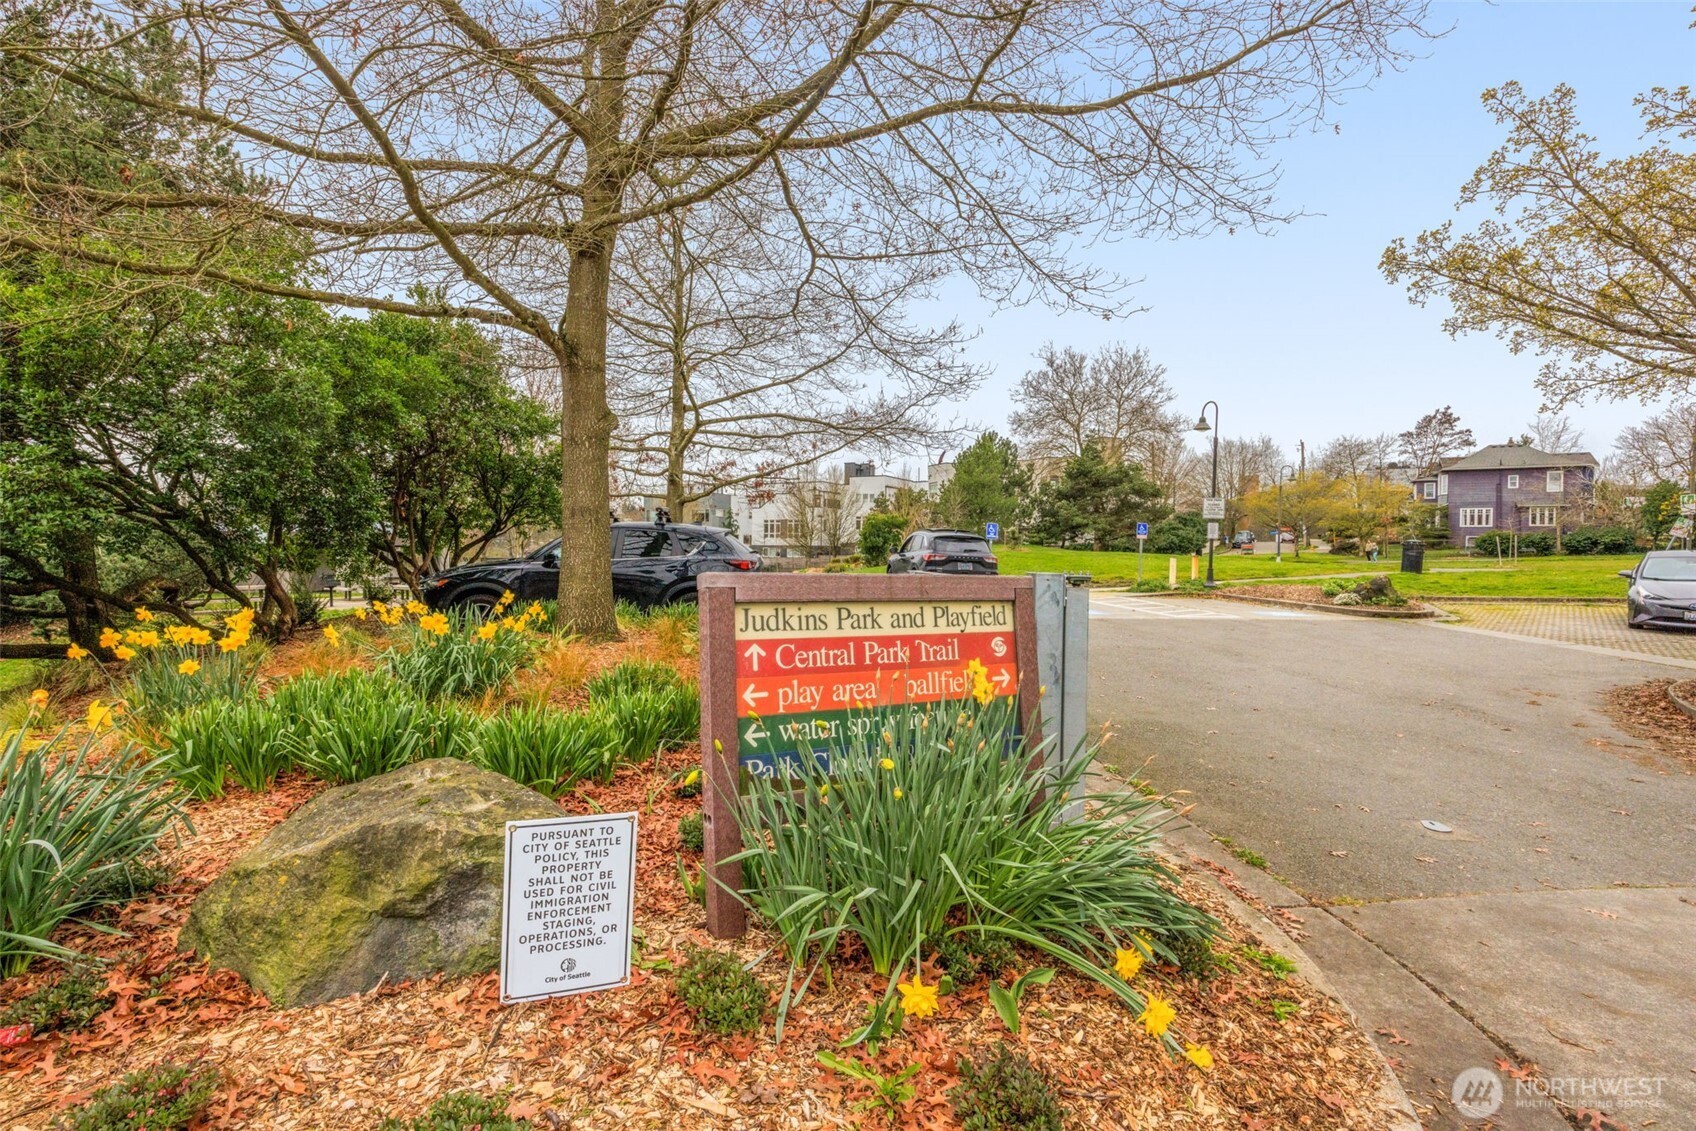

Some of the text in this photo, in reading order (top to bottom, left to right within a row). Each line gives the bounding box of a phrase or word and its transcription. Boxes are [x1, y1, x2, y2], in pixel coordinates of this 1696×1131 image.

[740, 604, 1007, 633] Judkins Park and Playfield
[775, 638, 960, 669] Central Park Trail
[904, 669, 977, 697] ballfiel
[778, 680, 878, 713] play area
[847, 713, 901, 742] spry
[531, 826, 614, 842] PURSUANT TO
[522, 836, 621, 854] CITY OF SEATTLE
[534, 849, 609, 864] POLICY, THIS
[541, 861, 602, 875] PROPERTY
[528, 870, 613, 887] SHALL NOT BE
[523, 881, 617, 899] USED FOR CIVIL
[530, 893, 609, 909] IMMIGRATION
[527, 903, 612, 921] ENFORCEMENT
[542, 917, 596, 930] STAGING,
[519, 924, 617, 945] OPERATIONS, OR
[530, 937, 606, 954] PROCESSING.
[567, 971, 591, 980] Seattle
